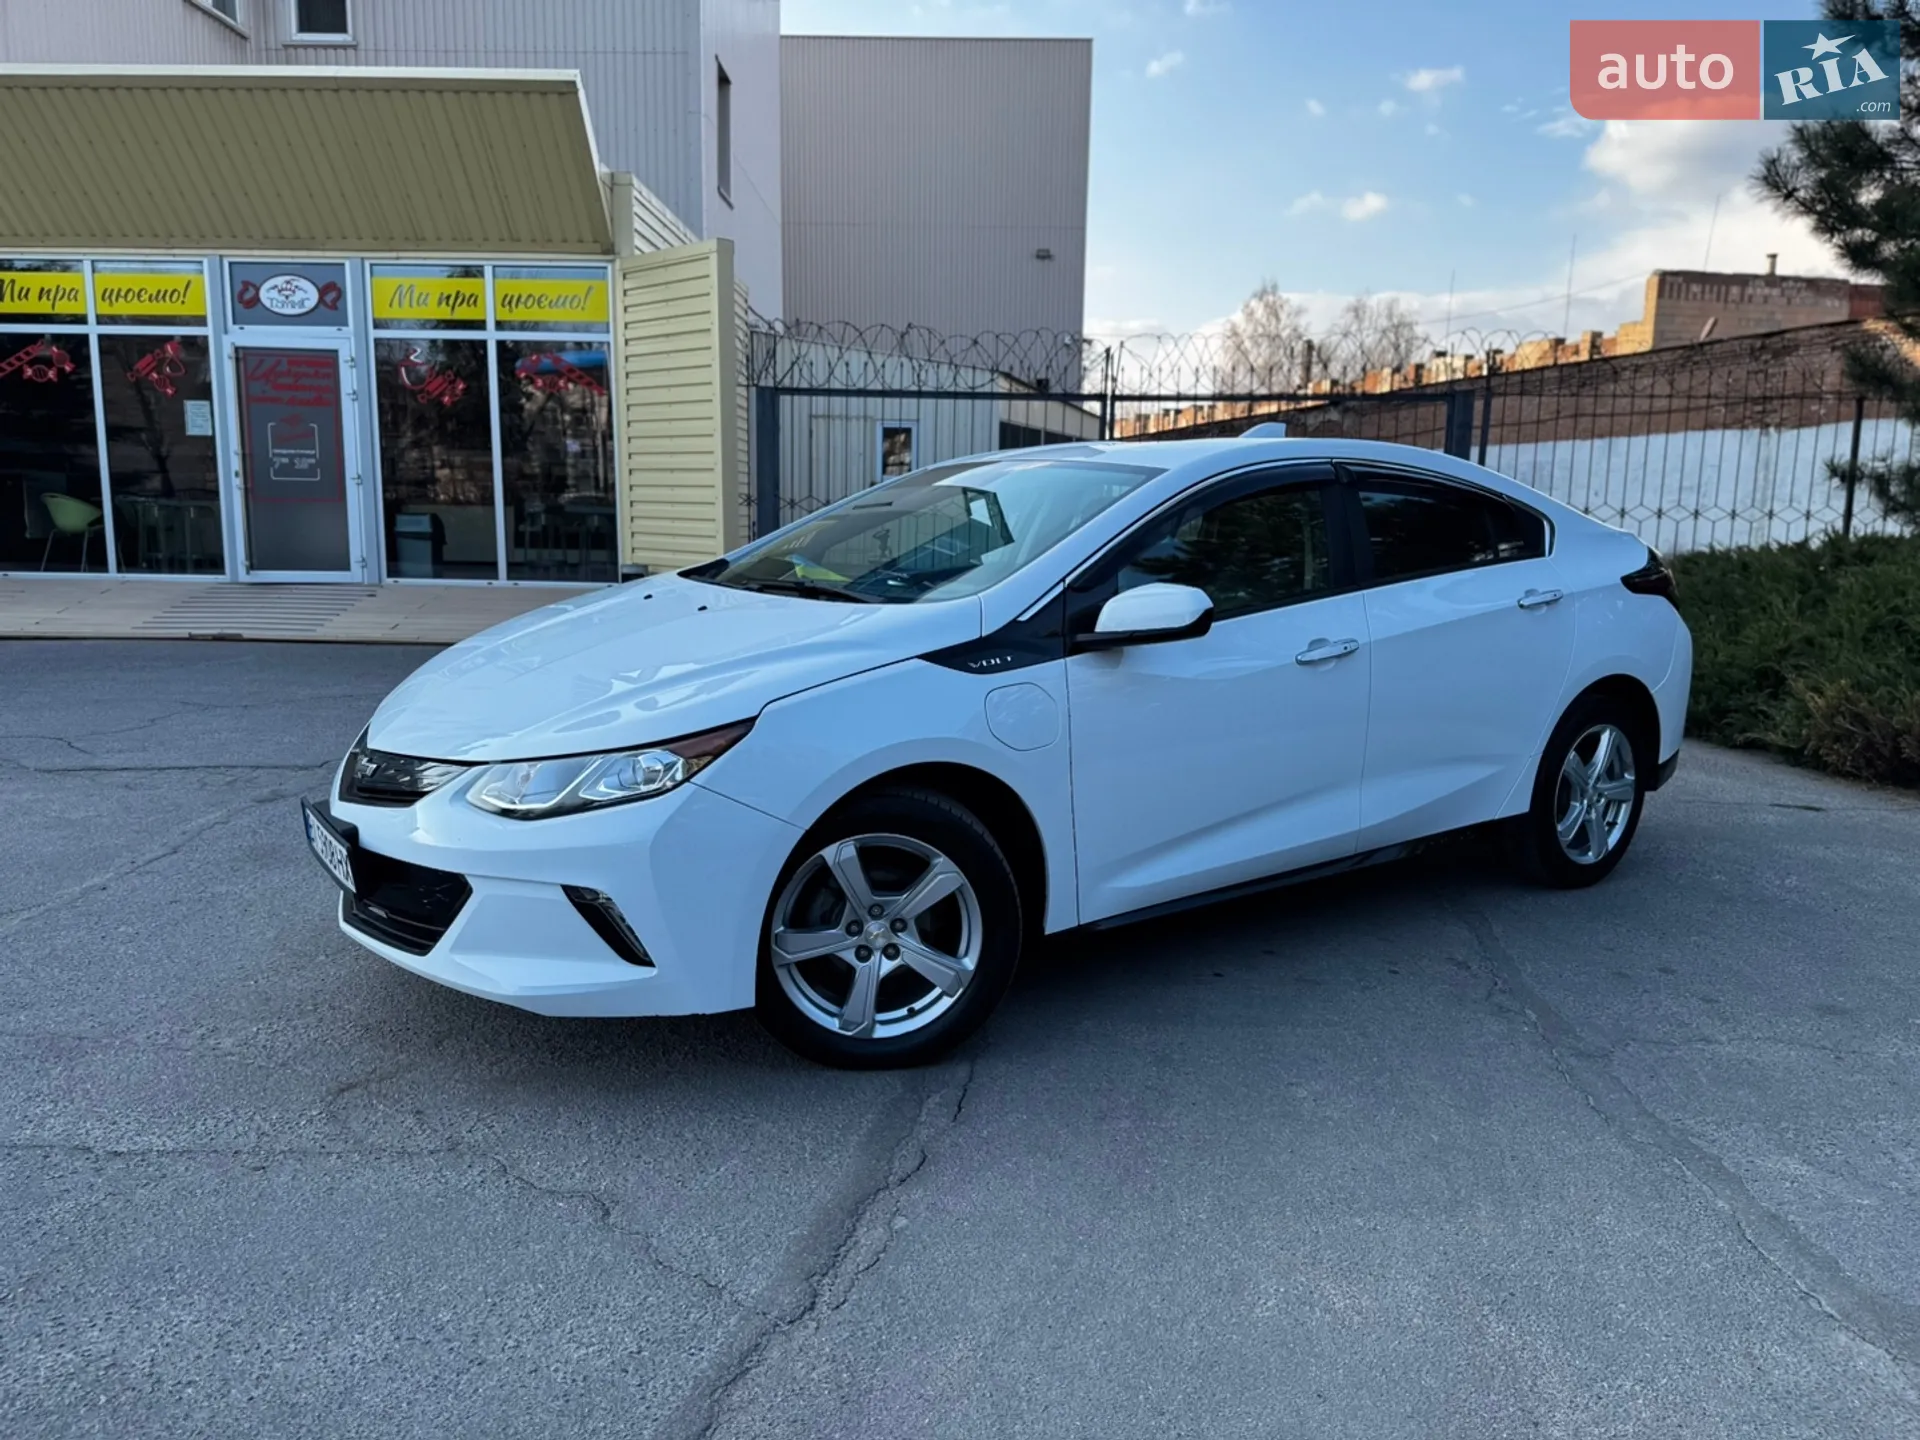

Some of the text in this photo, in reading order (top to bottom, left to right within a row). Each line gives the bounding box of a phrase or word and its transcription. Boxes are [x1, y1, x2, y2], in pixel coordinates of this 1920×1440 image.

[38, 284, 79, 311] пра
[101, 279, 192, 307] цюємо!
[389, 283, 594, 316] Ми пра цюємо!
[967, 655, 1014, 668] VOLT
